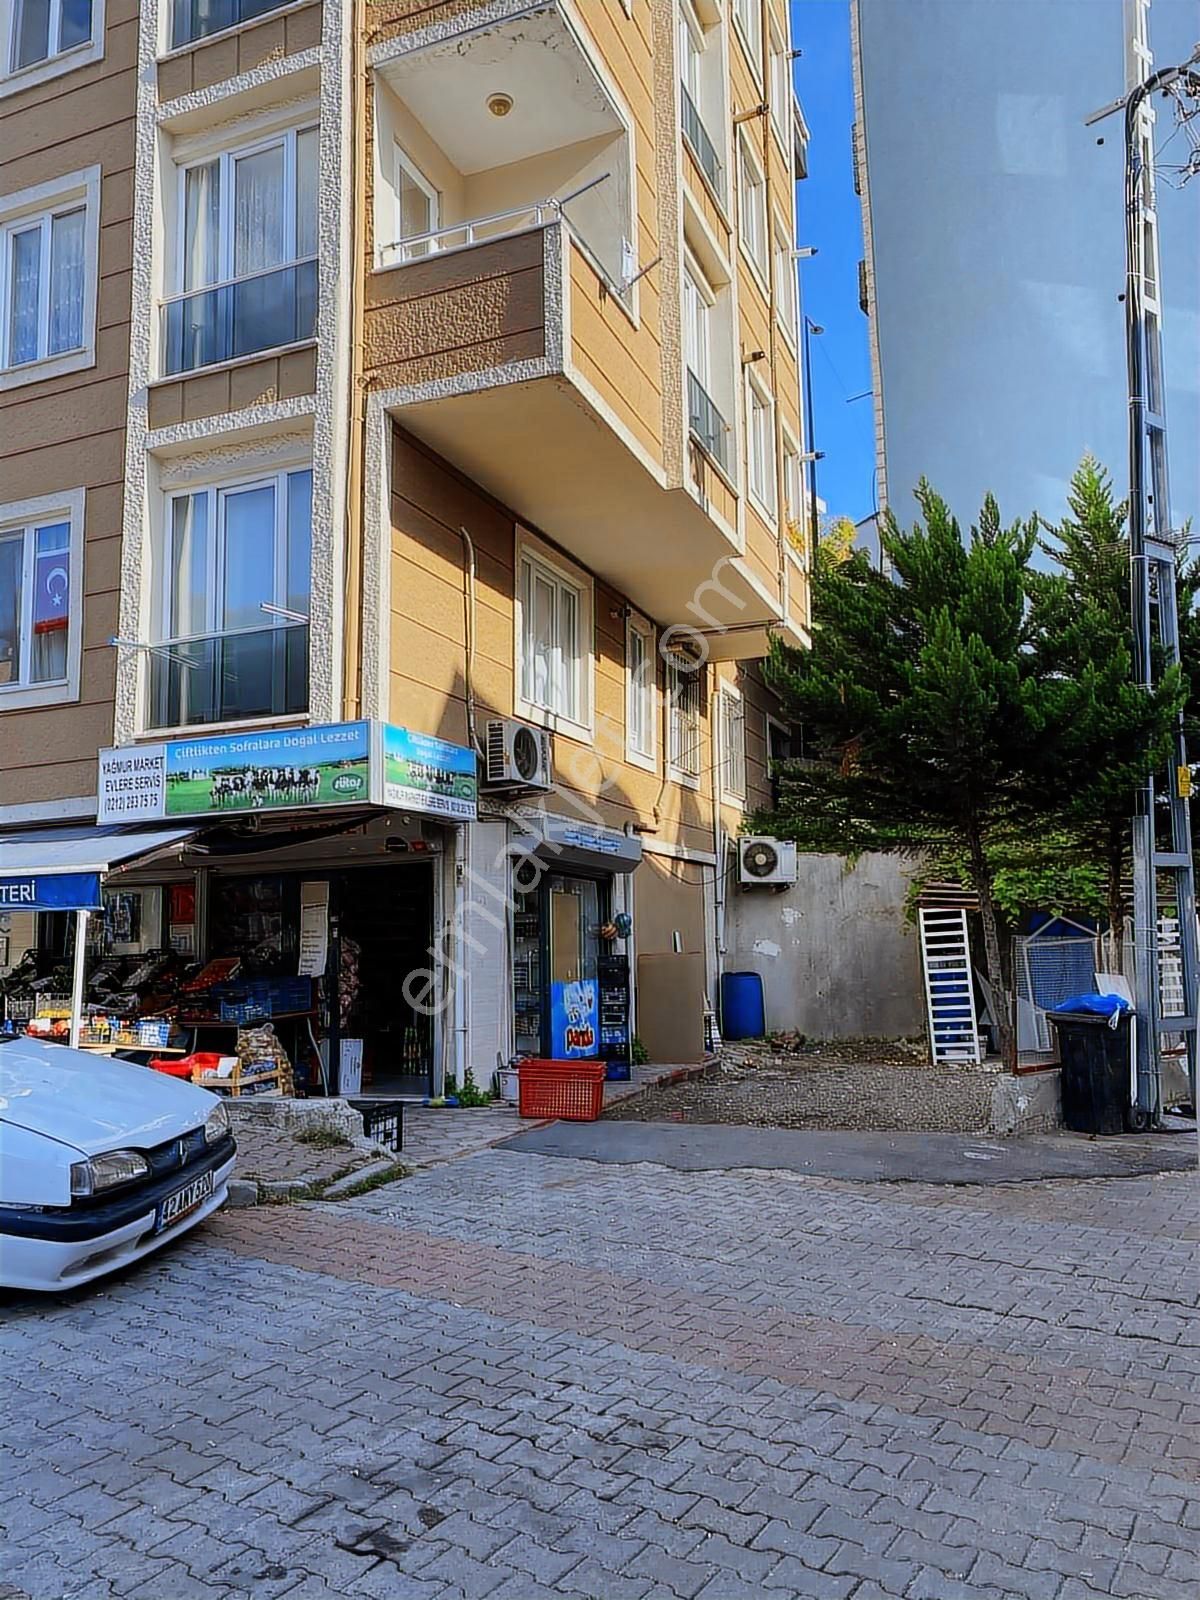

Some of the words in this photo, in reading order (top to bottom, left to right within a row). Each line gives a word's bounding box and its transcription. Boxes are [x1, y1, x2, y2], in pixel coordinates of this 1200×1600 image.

[230, 739, 281, 754] Sofralara
[320, 730, 360, 744] Lezzet
[133, 756, 165, 771] MARKET
[105, 777, 133, 792] EVLERE
[0, 880, 35, 902] TERİ
